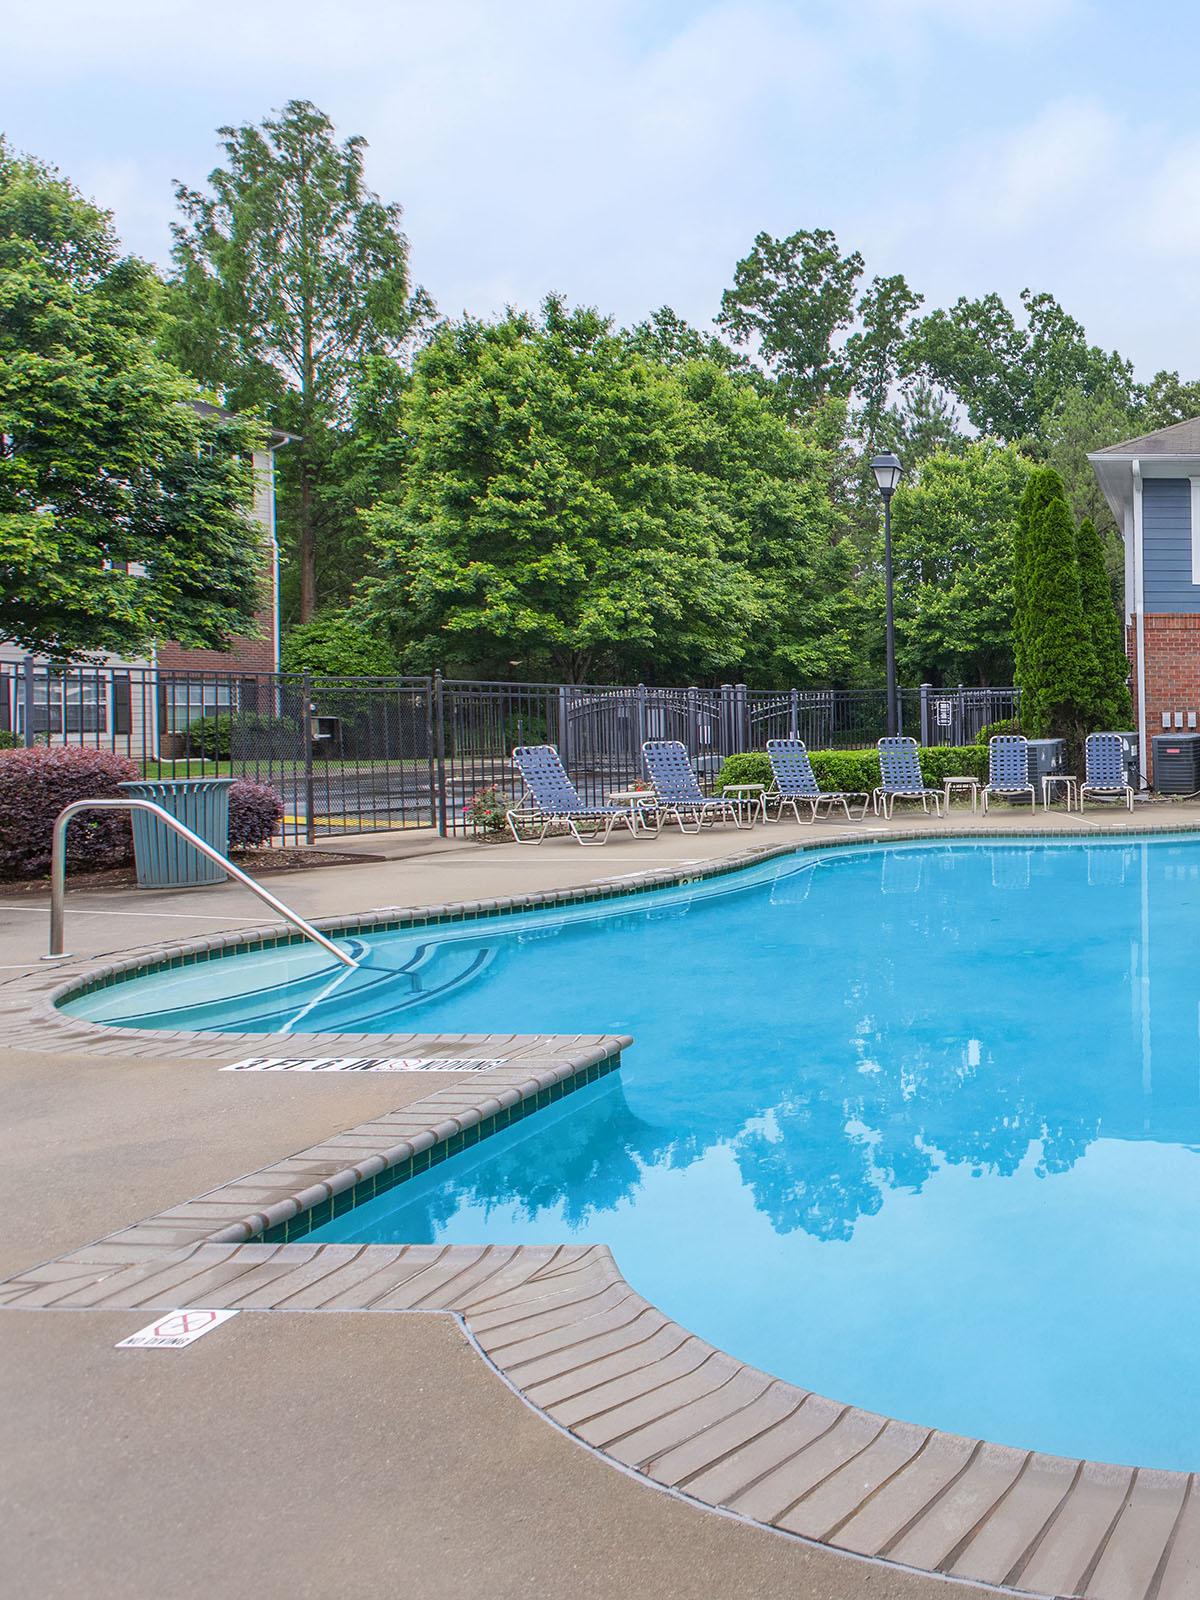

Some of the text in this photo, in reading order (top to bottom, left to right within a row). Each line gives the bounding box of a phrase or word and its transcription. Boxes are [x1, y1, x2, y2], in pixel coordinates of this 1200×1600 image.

[235, 1059, 269, 1070] 3
[262, 1059, 317, 1070] FT
[311, 1059, 344, 1070] 6
[340, 1059, 389, 1070] IN
